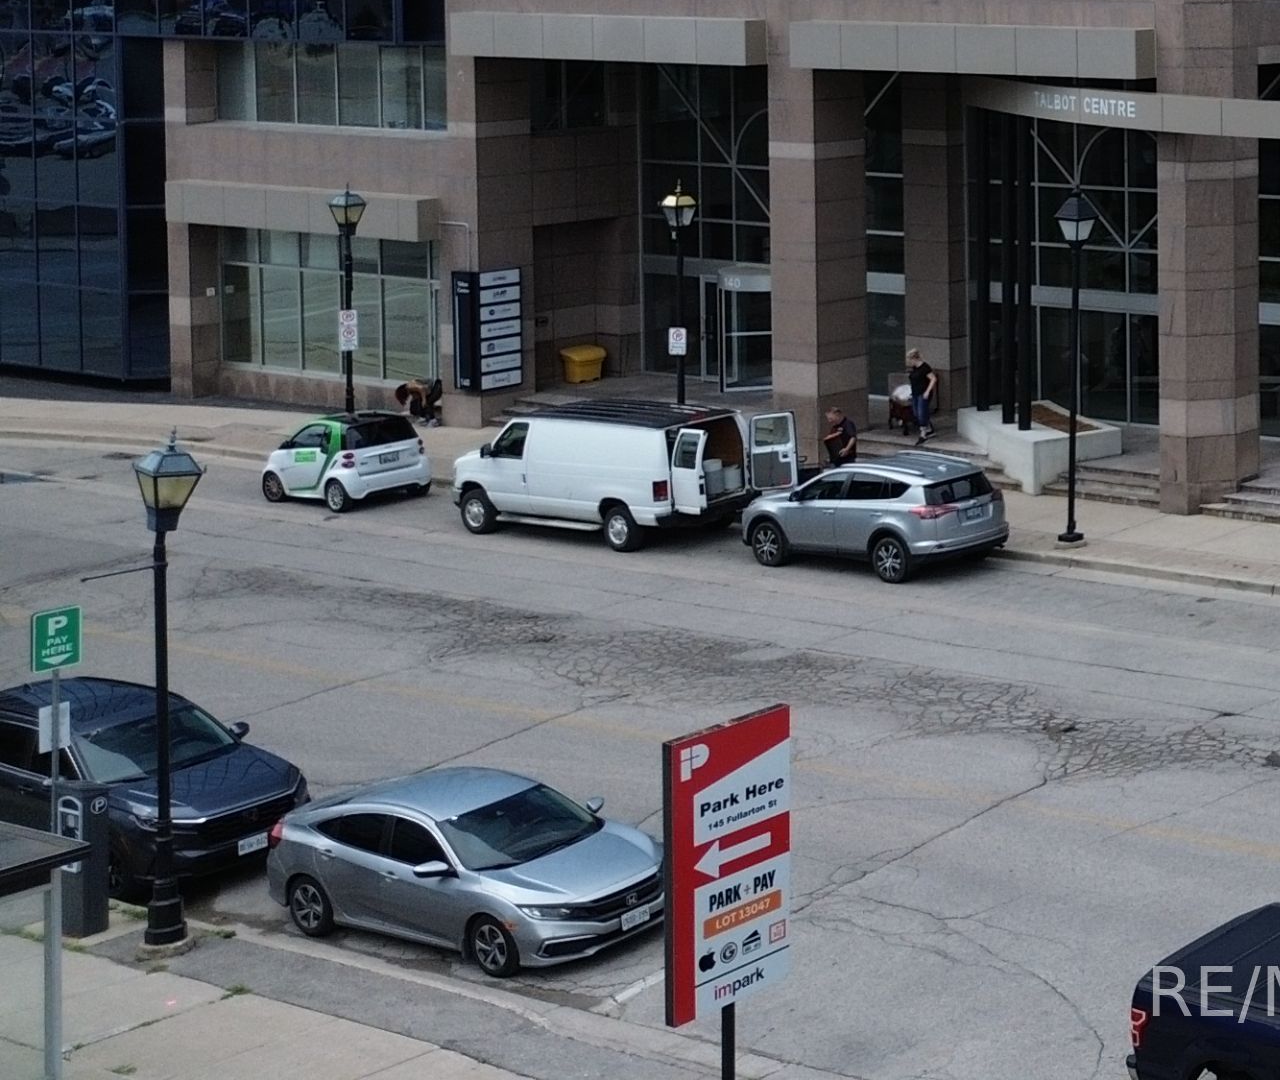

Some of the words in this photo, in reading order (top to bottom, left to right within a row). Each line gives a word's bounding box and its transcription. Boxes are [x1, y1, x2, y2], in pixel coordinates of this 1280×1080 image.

[1034, 91, 1076, 111] TALBOT
[1083, 97, 1136, 118] CENTRE
[47, 635, 68, 647] PAY
[48, 615, 68, 636] P
[41, 642, 73, 657] HERE
[700, 793, 740, 818] Park
[745, 778, 784, 801] Here
[708, 819, 725, 831] 145
[727, 805, 766, 824] Fullarton
[768, 799, 777, 808] St
[709, 883, 742, 912] PARK
[753, 869, 776, 894] PAY
[716, 912, 738, 929] LOT
[740, 898, 771, 920] 13047
[714, 967, 765, 1000] impark
